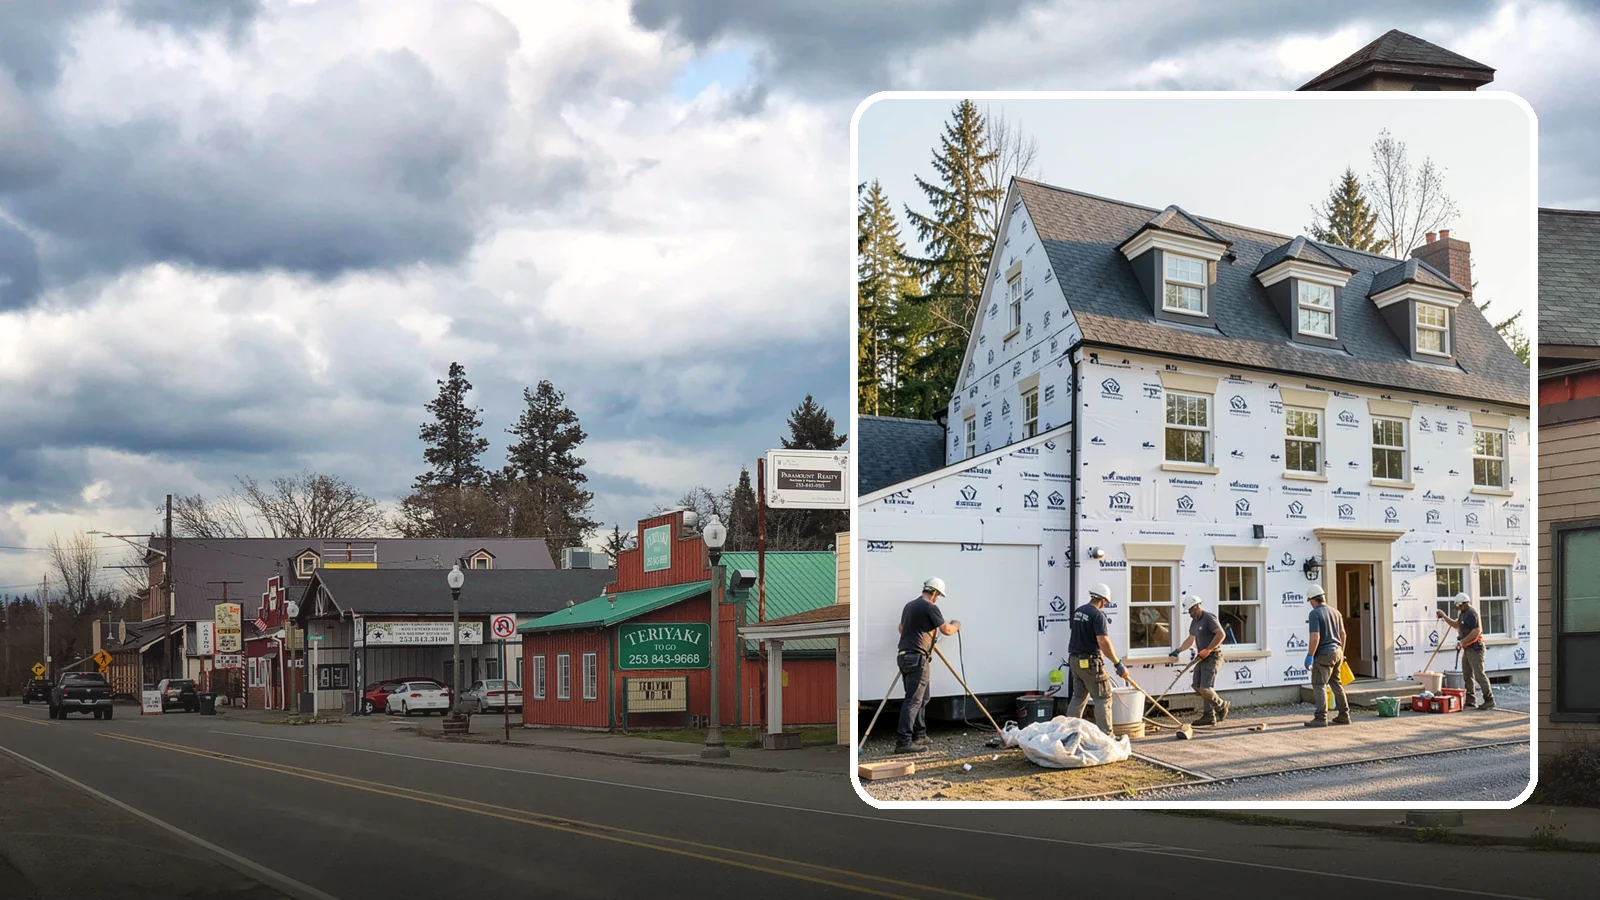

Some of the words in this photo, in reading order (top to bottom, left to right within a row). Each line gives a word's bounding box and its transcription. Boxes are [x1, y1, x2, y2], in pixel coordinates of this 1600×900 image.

[625, 627, 702, 646] TERIYAKI
[629, 654, 648, 664] 253
[651, 654, 700, 664] 843-9668
